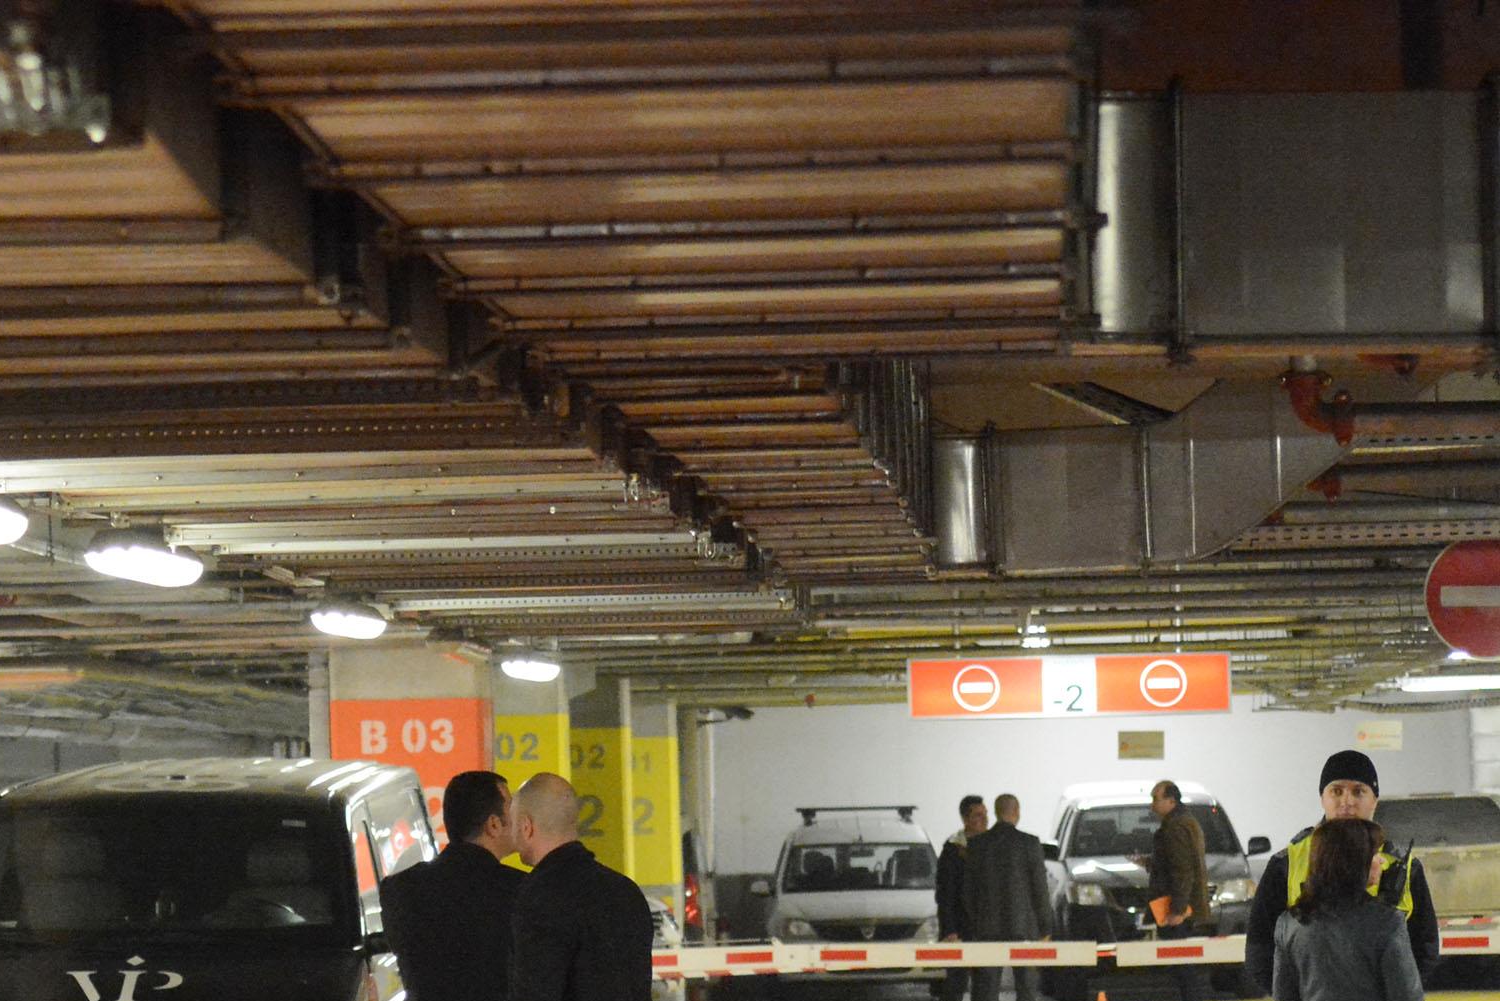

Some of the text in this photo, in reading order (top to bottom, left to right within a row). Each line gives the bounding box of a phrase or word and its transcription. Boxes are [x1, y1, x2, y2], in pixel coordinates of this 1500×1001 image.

[1053, 684, 1084, 712] -2
[360, 718, 455, 755] B 03
[494, 732, 540, 761] 02
